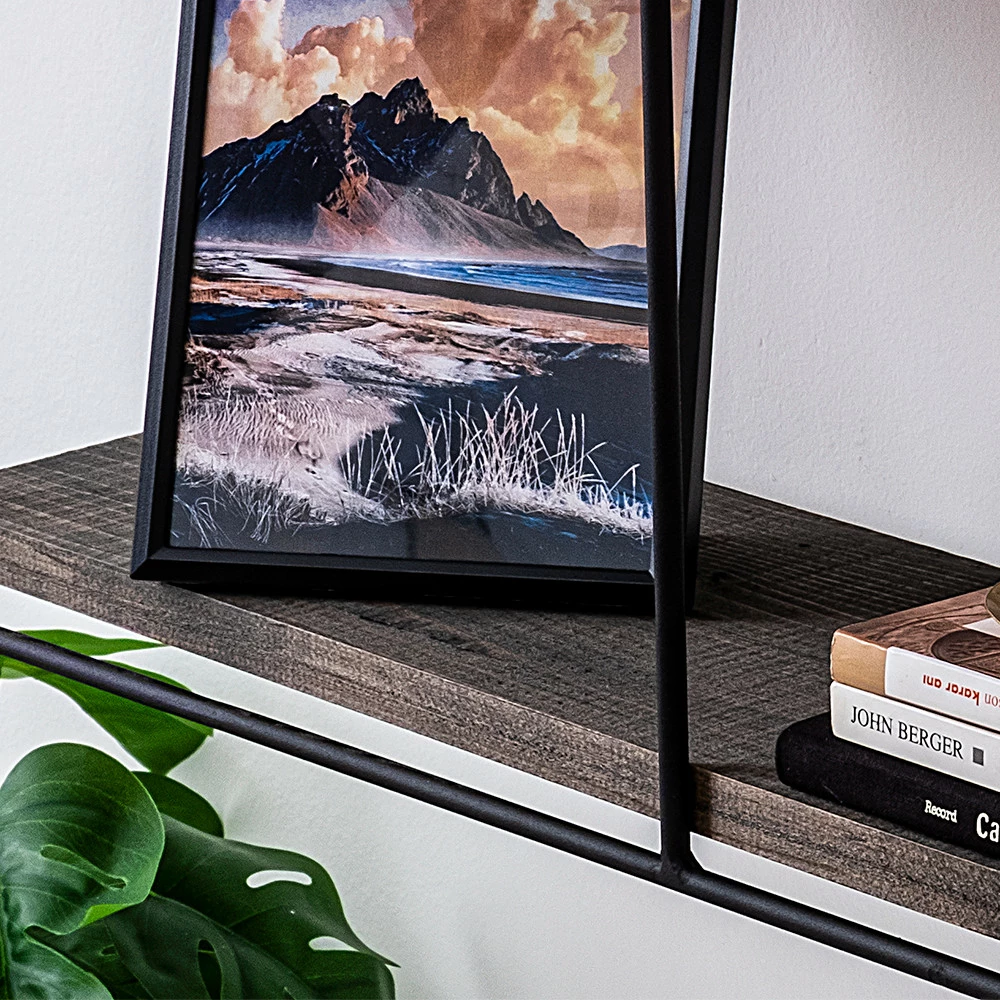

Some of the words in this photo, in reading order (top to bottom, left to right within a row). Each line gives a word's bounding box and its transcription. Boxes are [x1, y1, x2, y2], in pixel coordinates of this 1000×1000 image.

[945, 682, 980, 706] karar
[850, 705, 893, 735] JOHN
[898, 720, 964, 760] BERGER
[924, 799, 958, 824] Record
